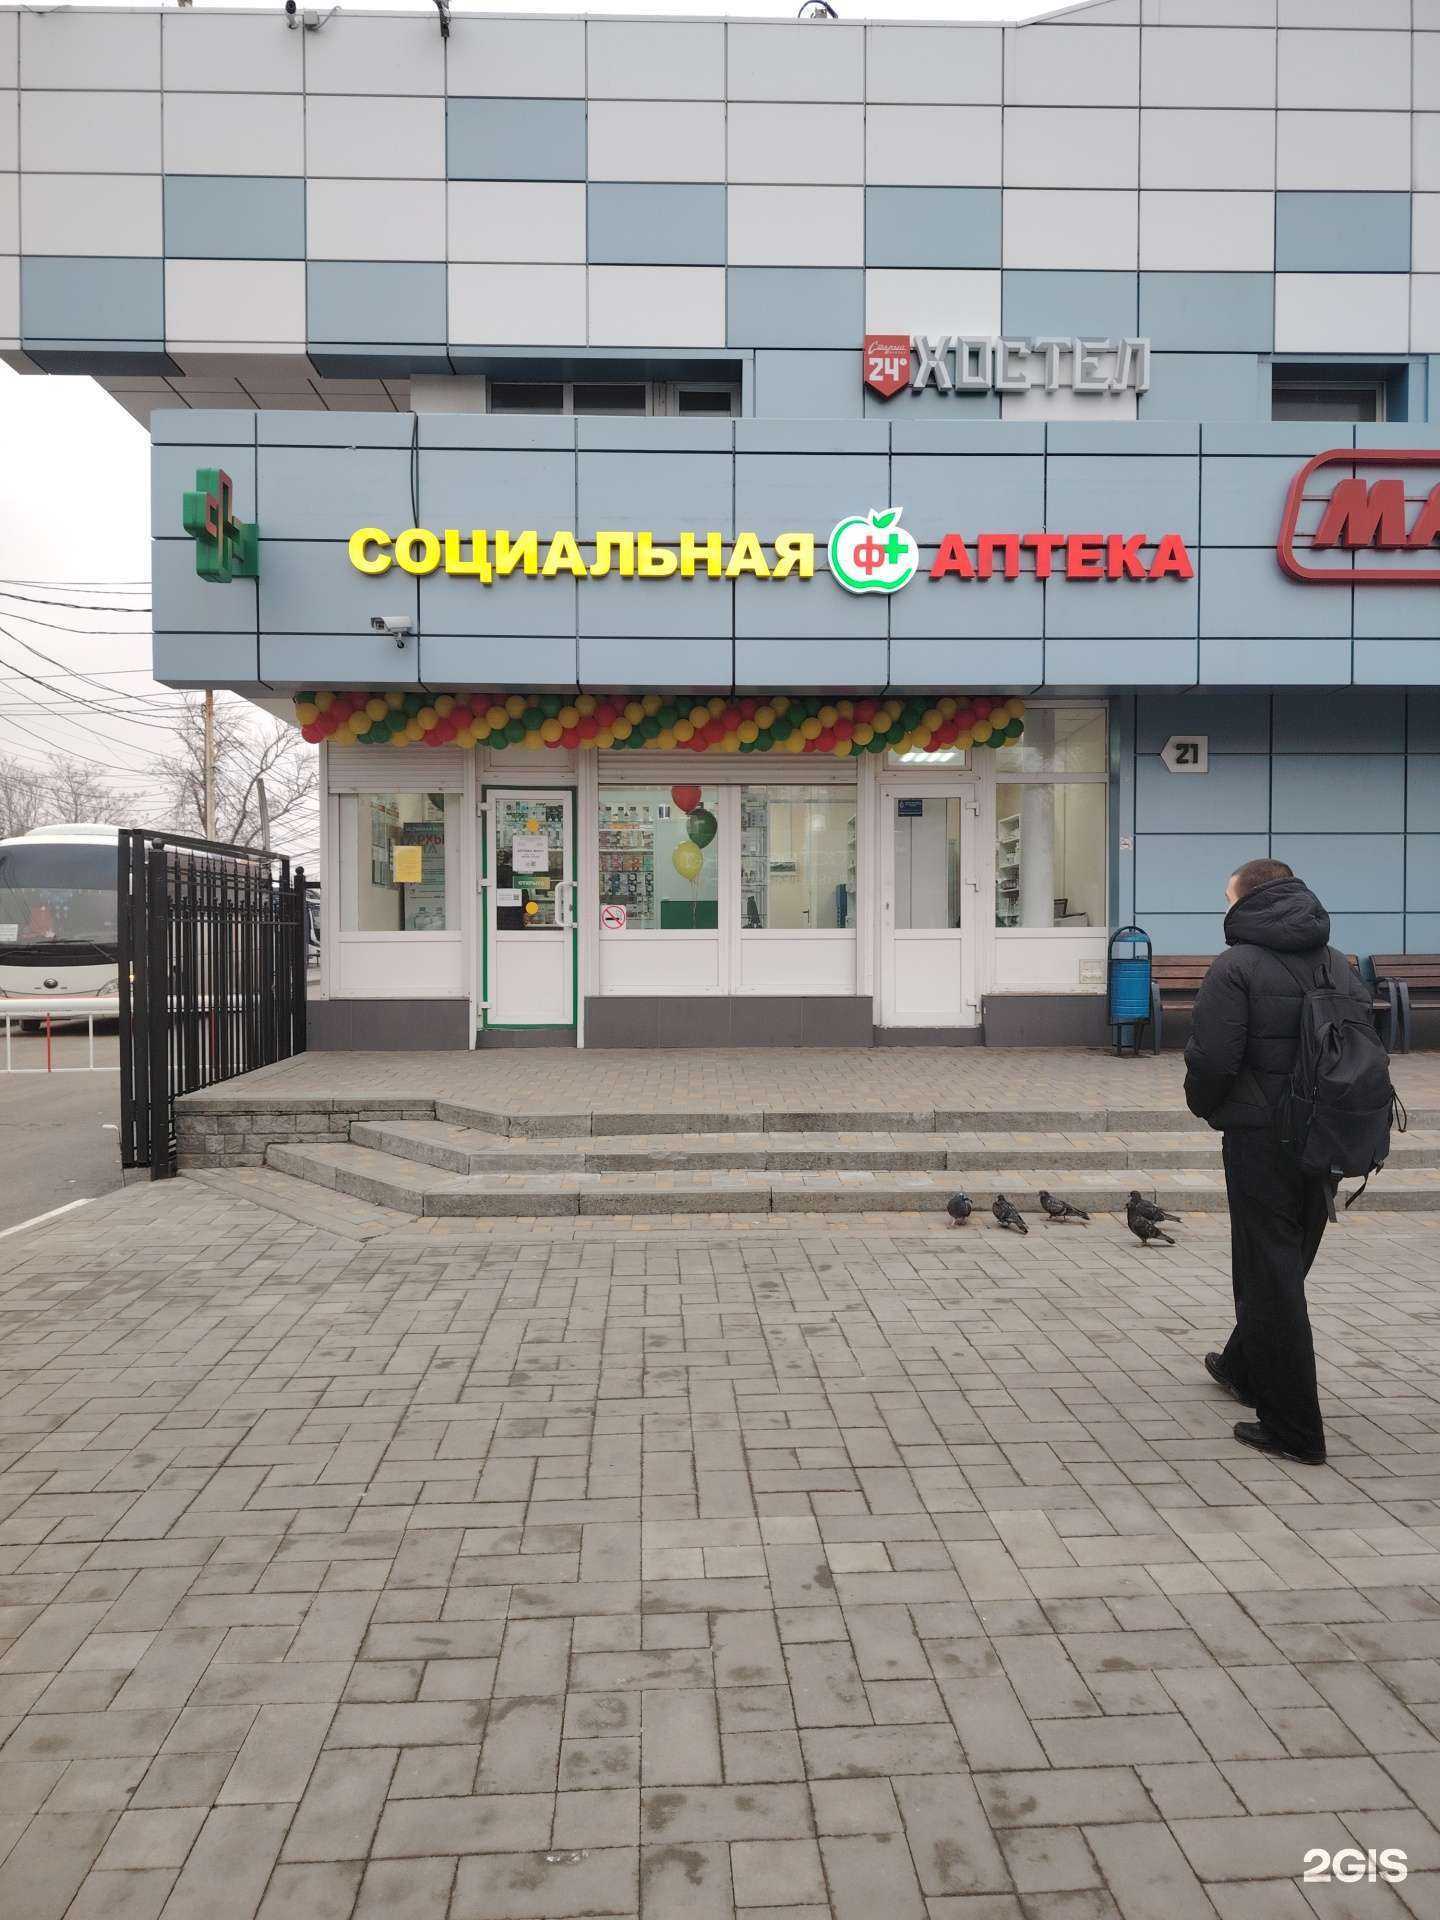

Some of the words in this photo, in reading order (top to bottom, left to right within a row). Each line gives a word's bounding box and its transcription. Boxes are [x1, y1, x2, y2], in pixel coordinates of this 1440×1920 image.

[911, 336, 1151, 394] ХОСТЕЛ
[347, 526, 816, 585] СОЦИАЛЬНАЯ
[928, 533, 1195, 582] АПТЕКА
[1174, 743, 1200, 765] 21
